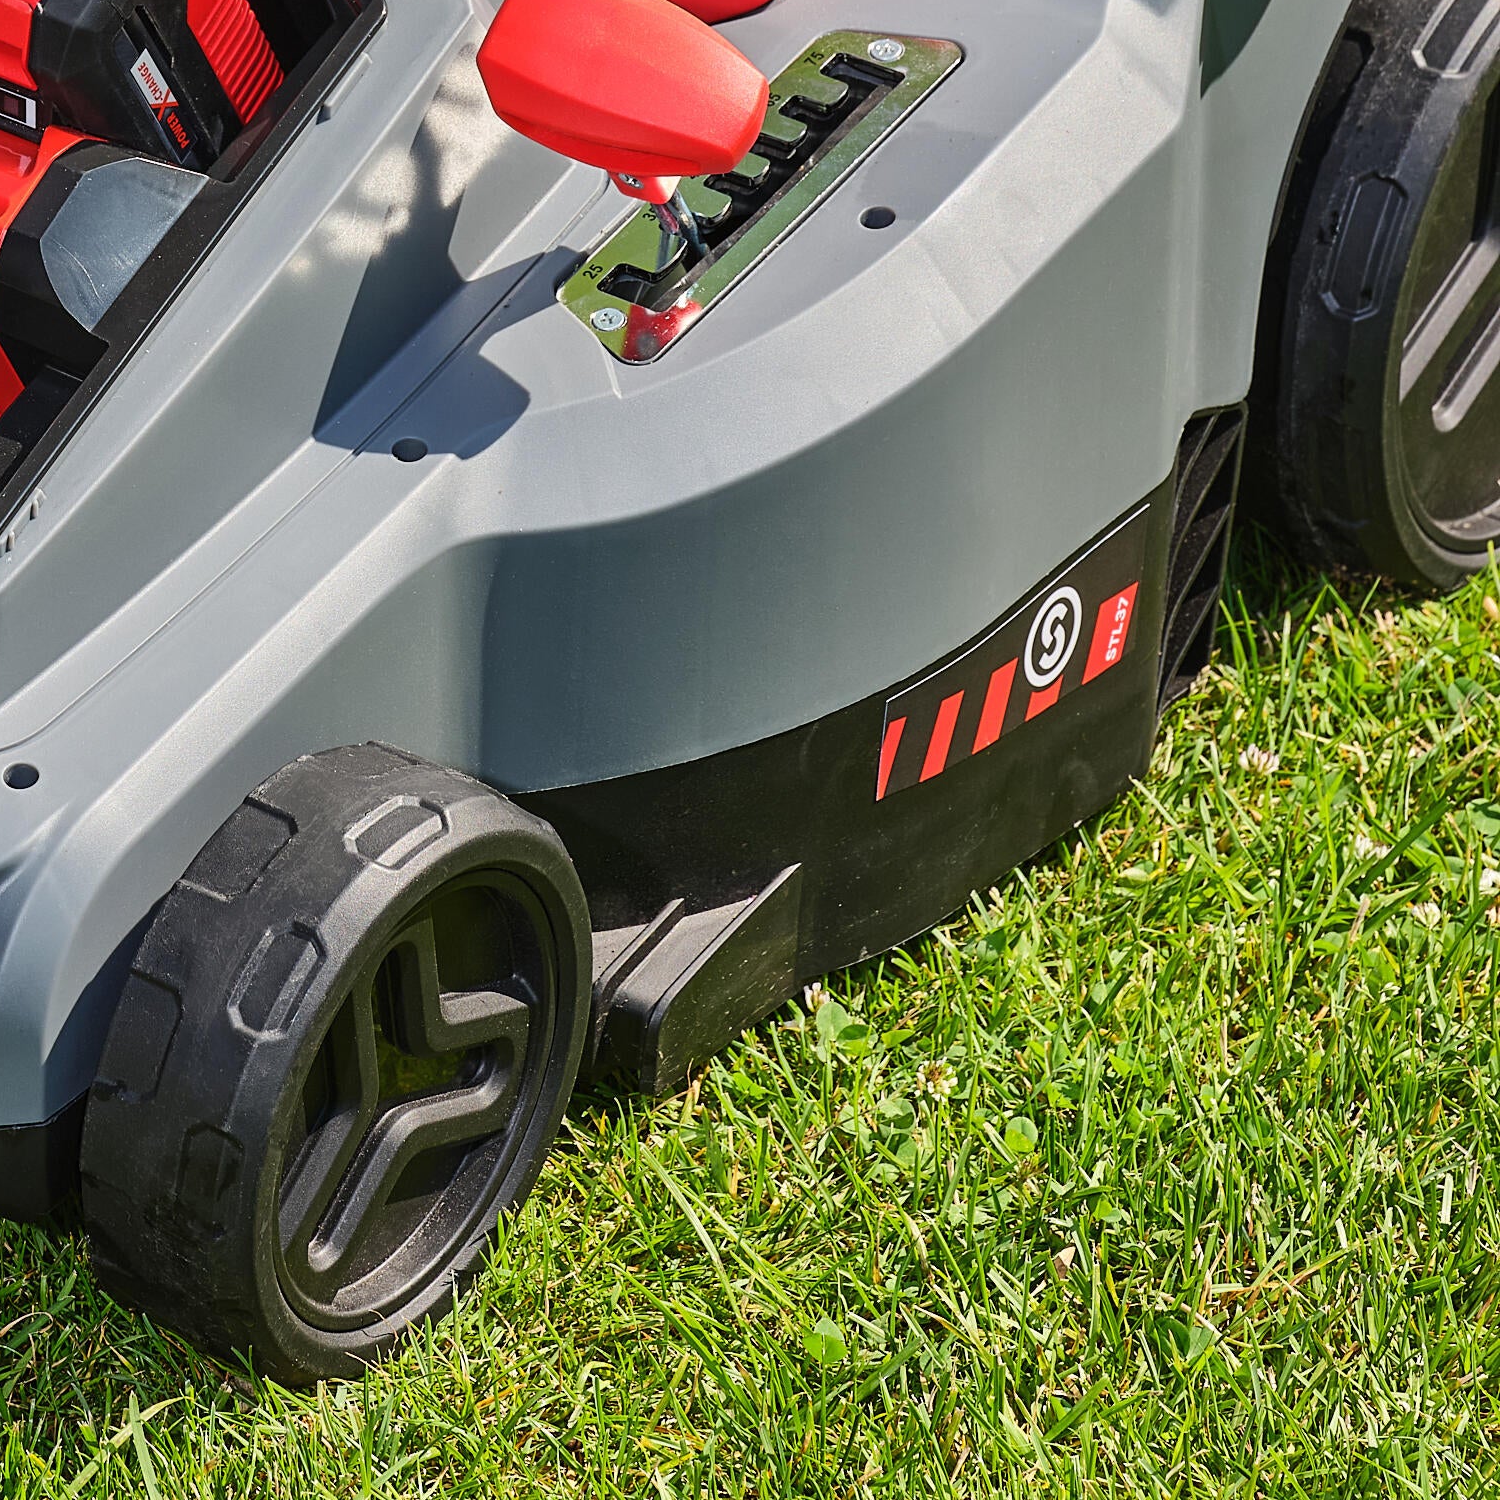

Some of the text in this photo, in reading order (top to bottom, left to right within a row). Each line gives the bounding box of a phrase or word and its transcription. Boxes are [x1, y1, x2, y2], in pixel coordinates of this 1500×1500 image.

[804, 52, 824, 65] 75
[167, 112, 190, 149] POWER
[582, 264, 603, 279] 25
[1105, 596, 1129, 661] STL37
